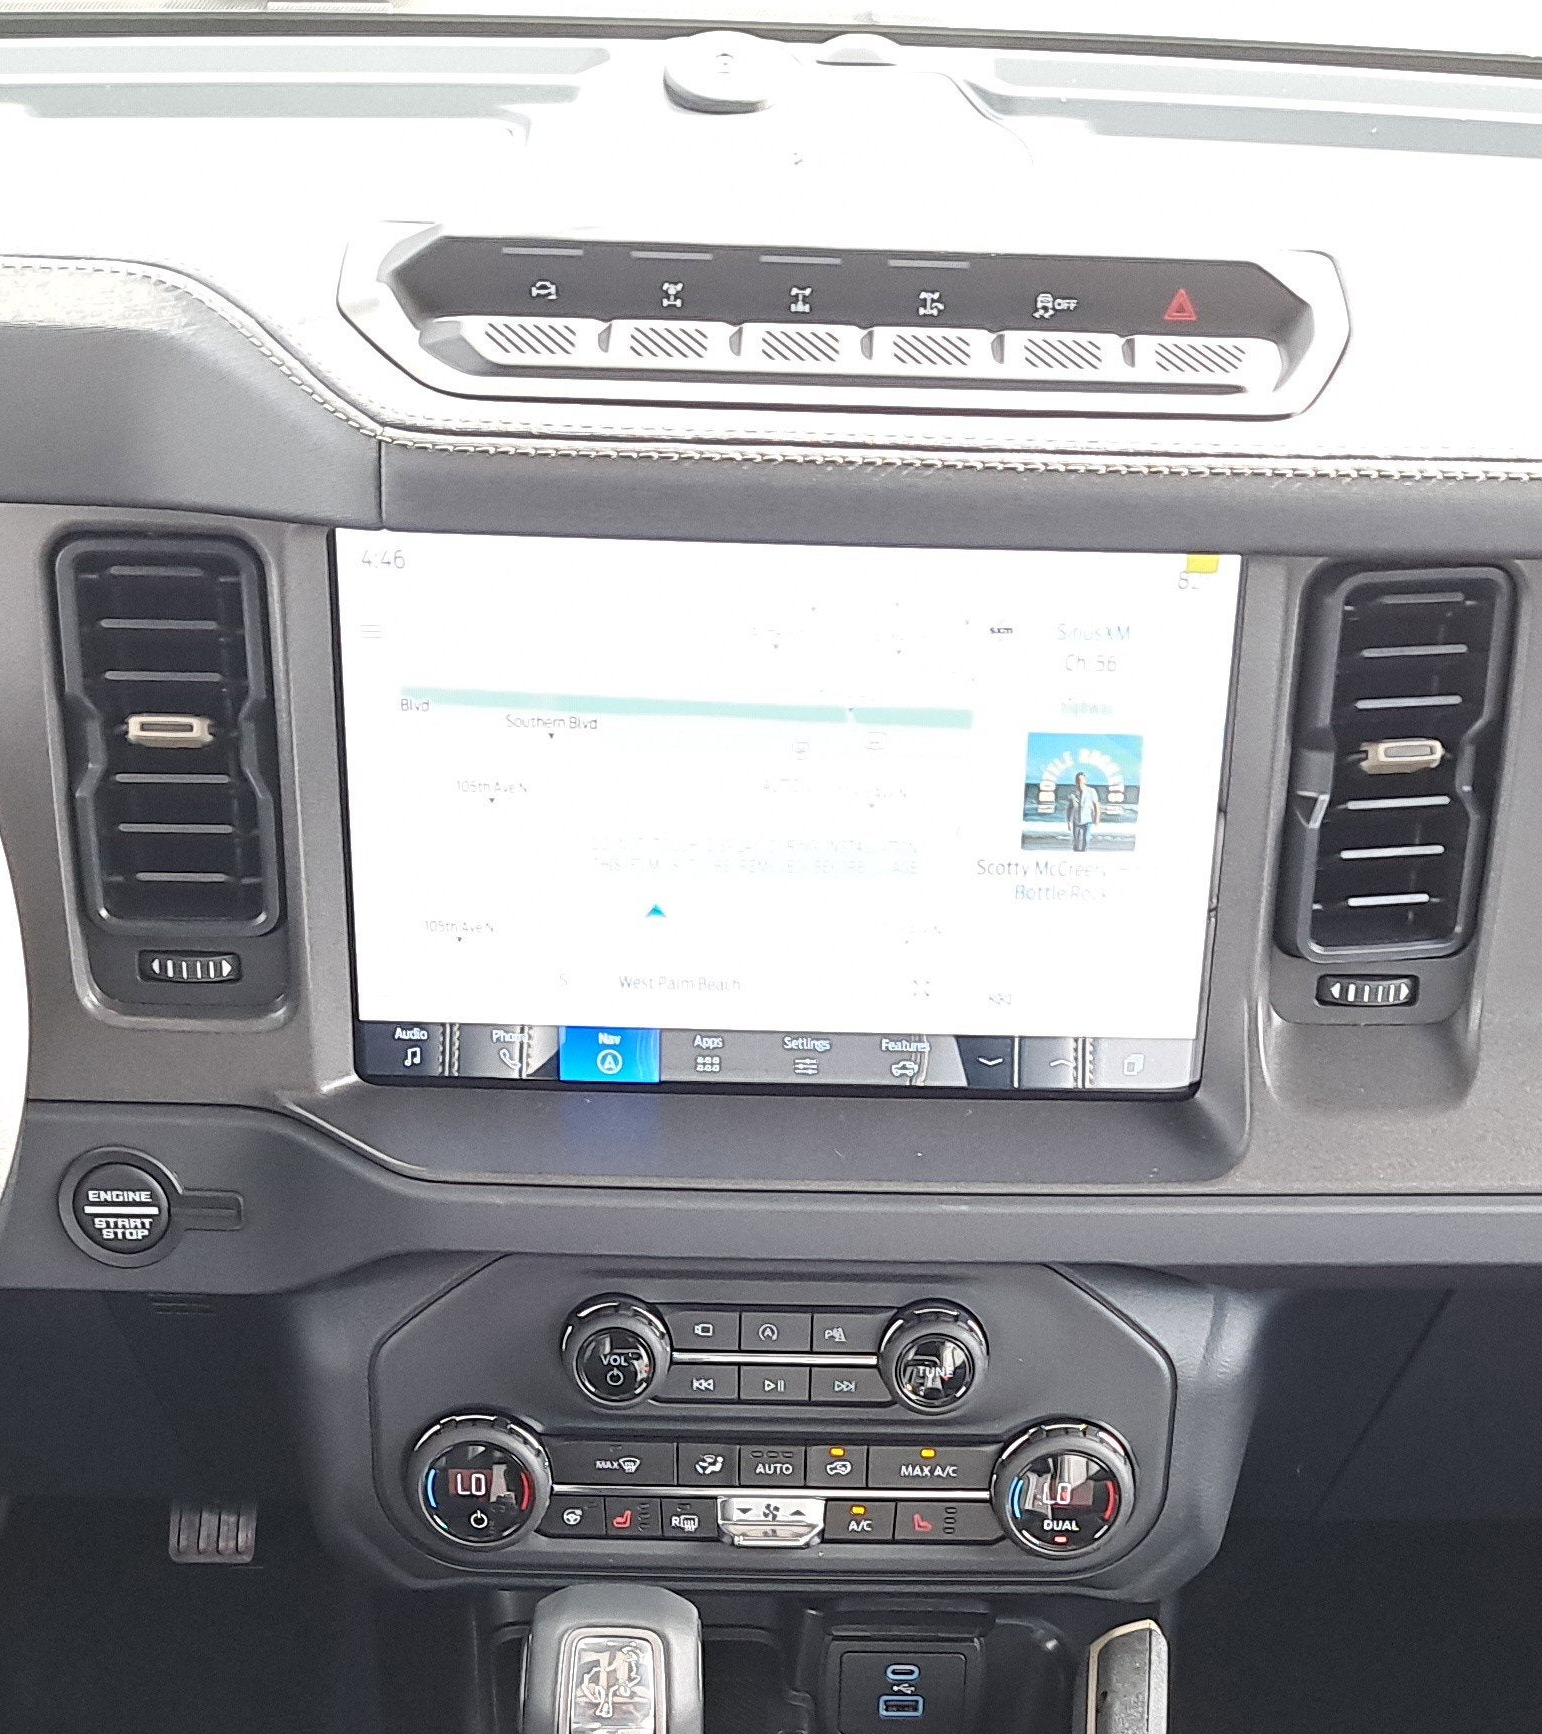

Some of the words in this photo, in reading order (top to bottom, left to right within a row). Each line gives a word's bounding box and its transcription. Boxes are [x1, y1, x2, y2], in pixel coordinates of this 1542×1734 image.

[1054, 298, 1078, 311] OFF
[361, 548, 406, 570] 4:46
[401, 698, 429, 713] Blvd
[569, 716, 599, 731] Blvd
[977, 859, 1029, 878] Scotty
[395, 1026, 427, 1041] Audio
[598, 1032, 622, 1046] Nav
[693, 1034, 724, 1050] Apps
[783, 1036, 831, 1053] Settings
[880, 1038, 931, 1053] Features
[88, 1190, 153, 1202] ENGINE
[94, 1218, 153, 1229] START
[102, 1229, 149, 1240] STOP
[601, 1354, 629, 1366] VOL
[917, 1366, 954, 1378] TUNE
[595, 1460, 619, 1470] MAX
[755, 1464, 793, 1475] AUTO
[900, 1465, 930, 1477] MAX
[934, 1465, 958, 1477] A/C
[456, 1473, 486, 1496] LO
[848, 1520, 873, 1532] A/C
[1043, 1520, 1079, 1531] DUAL
